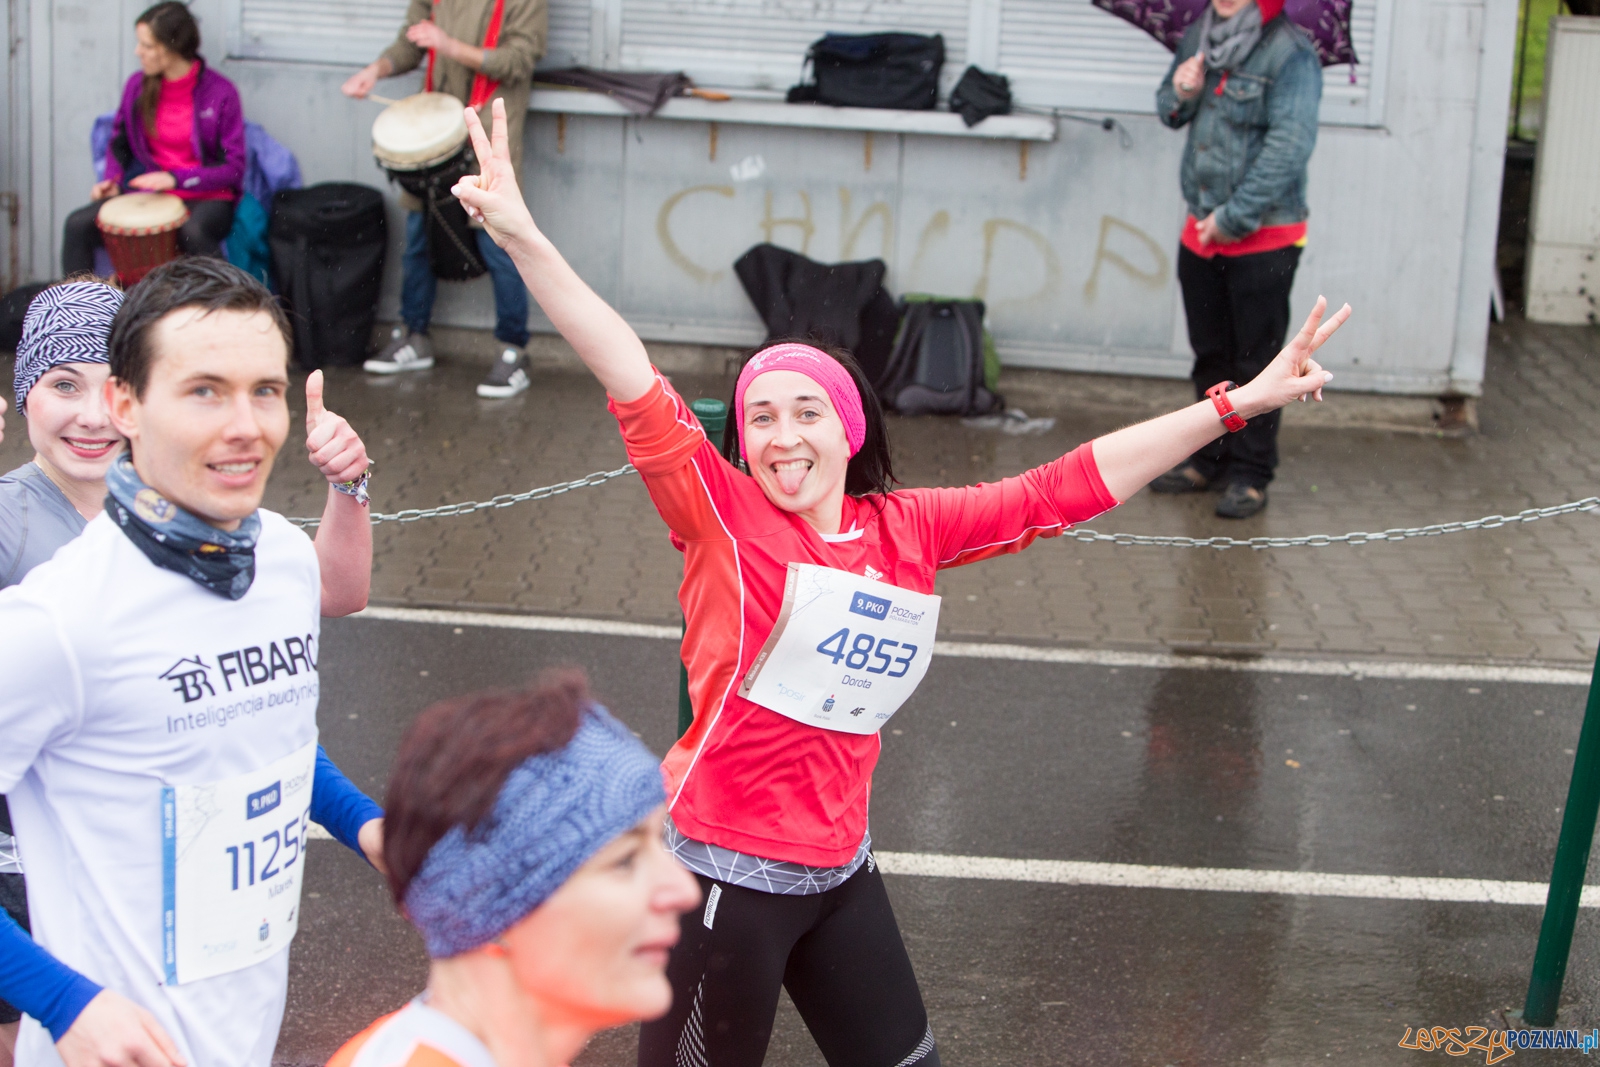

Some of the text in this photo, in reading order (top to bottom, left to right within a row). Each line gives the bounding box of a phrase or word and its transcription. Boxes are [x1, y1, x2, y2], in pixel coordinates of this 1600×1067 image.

[816, 627, 918, 678] 4853
[841, 674, 872, 689] Dorota
[167, 694, 264, 733] Inteligencja
